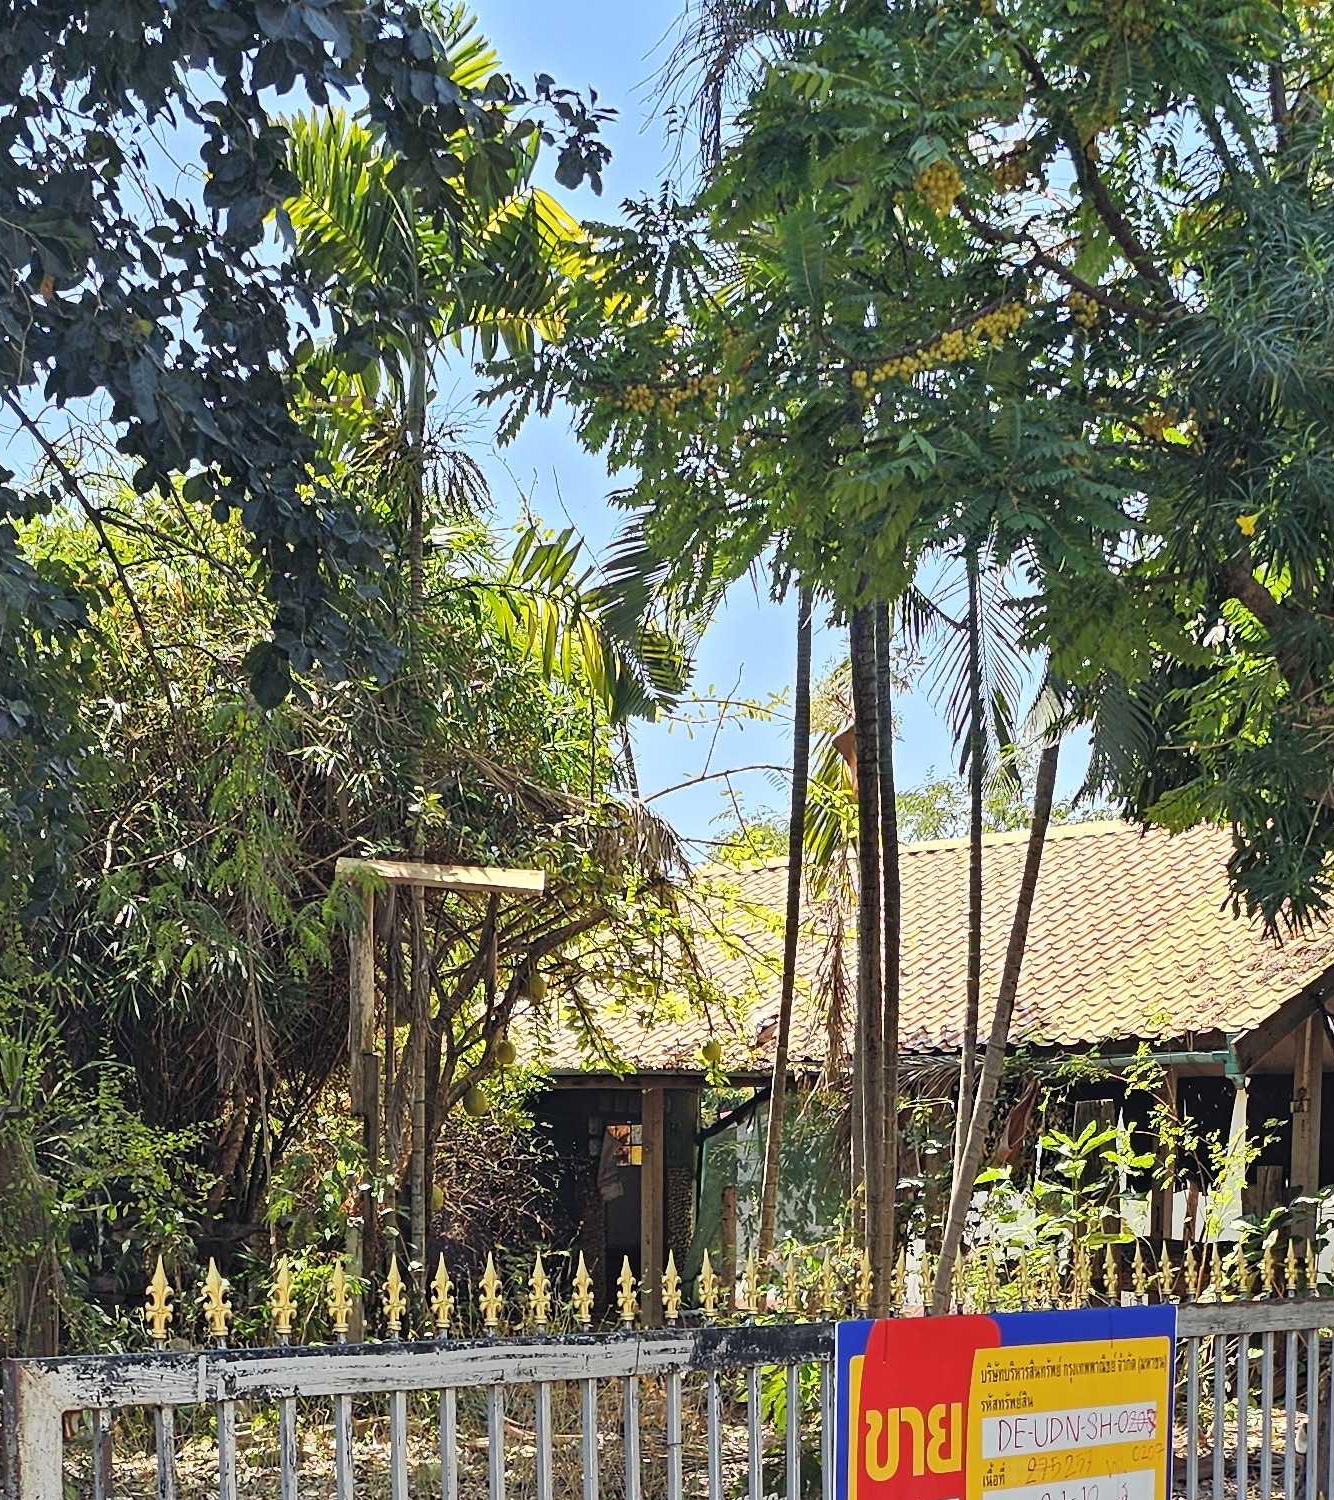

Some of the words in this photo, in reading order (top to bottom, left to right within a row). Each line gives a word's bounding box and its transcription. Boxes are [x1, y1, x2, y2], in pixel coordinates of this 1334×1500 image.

[981, 1356, 1062, 1383] บริษัทบริหารสินทรัพย์
[981, 1390, 1033, 1412] รหัสทรัพย์สิน
[865, 1402, 962, 1482] ขาย
[982, 1462, 1005, 1487] เนื้อที่
